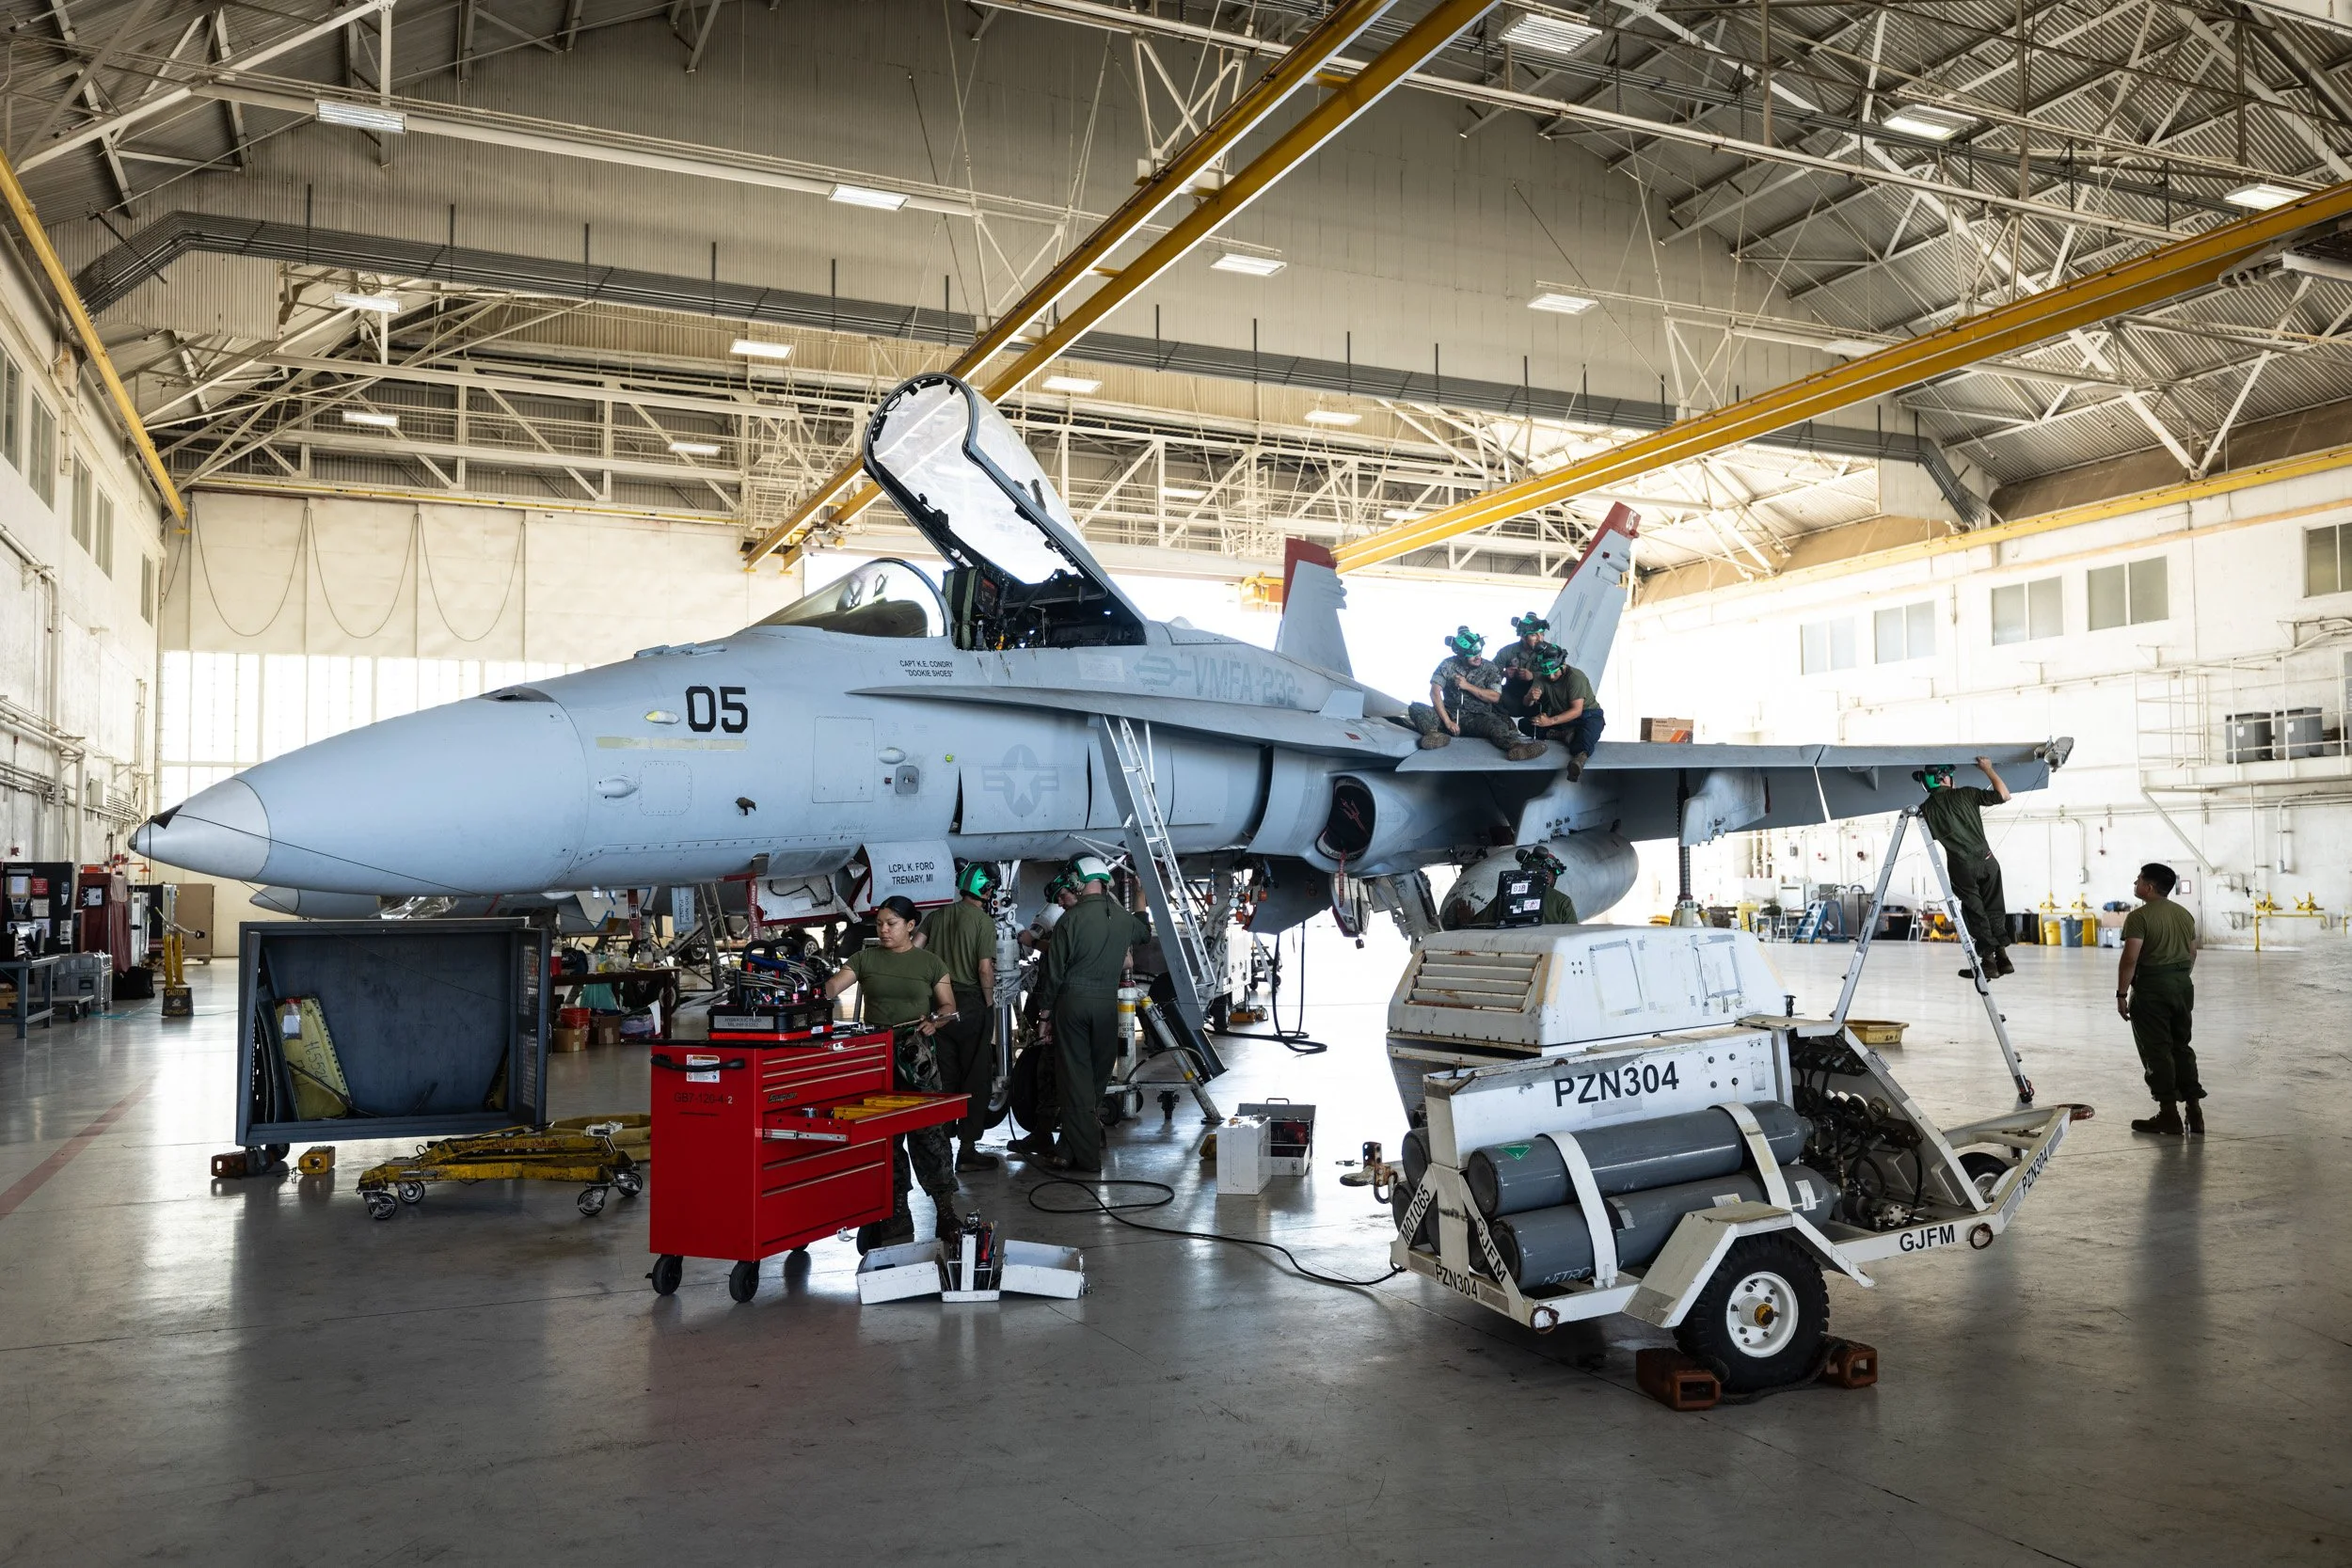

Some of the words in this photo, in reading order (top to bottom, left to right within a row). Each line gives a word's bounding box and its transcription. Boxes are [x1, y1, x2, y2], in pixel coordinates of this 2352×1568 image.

[1626, 510, 1637, 531] 05
[899, 659, 915, 668] CAPT
[685, 686, 749, 734] 05
[888, 863, 907, 873] LCPL
[891, 874, 925, 885] TRENARY,
[926, 873, 934, 882] MI
[685, 895, 690, 906] DO
[166, 989, 187, 997] CAUTION
[1554, 1060, 1679, 1107] PZN304
[2022, 1146, 2048, 1196] PZN304
[1401, 1183, 1431, 1246] M01065
[1477, 1217, 1507, 1282] GJFM
[1899, 1224, 1956, 1252] GJFM
[1435, 1262, 1478, 1299] PZN304
